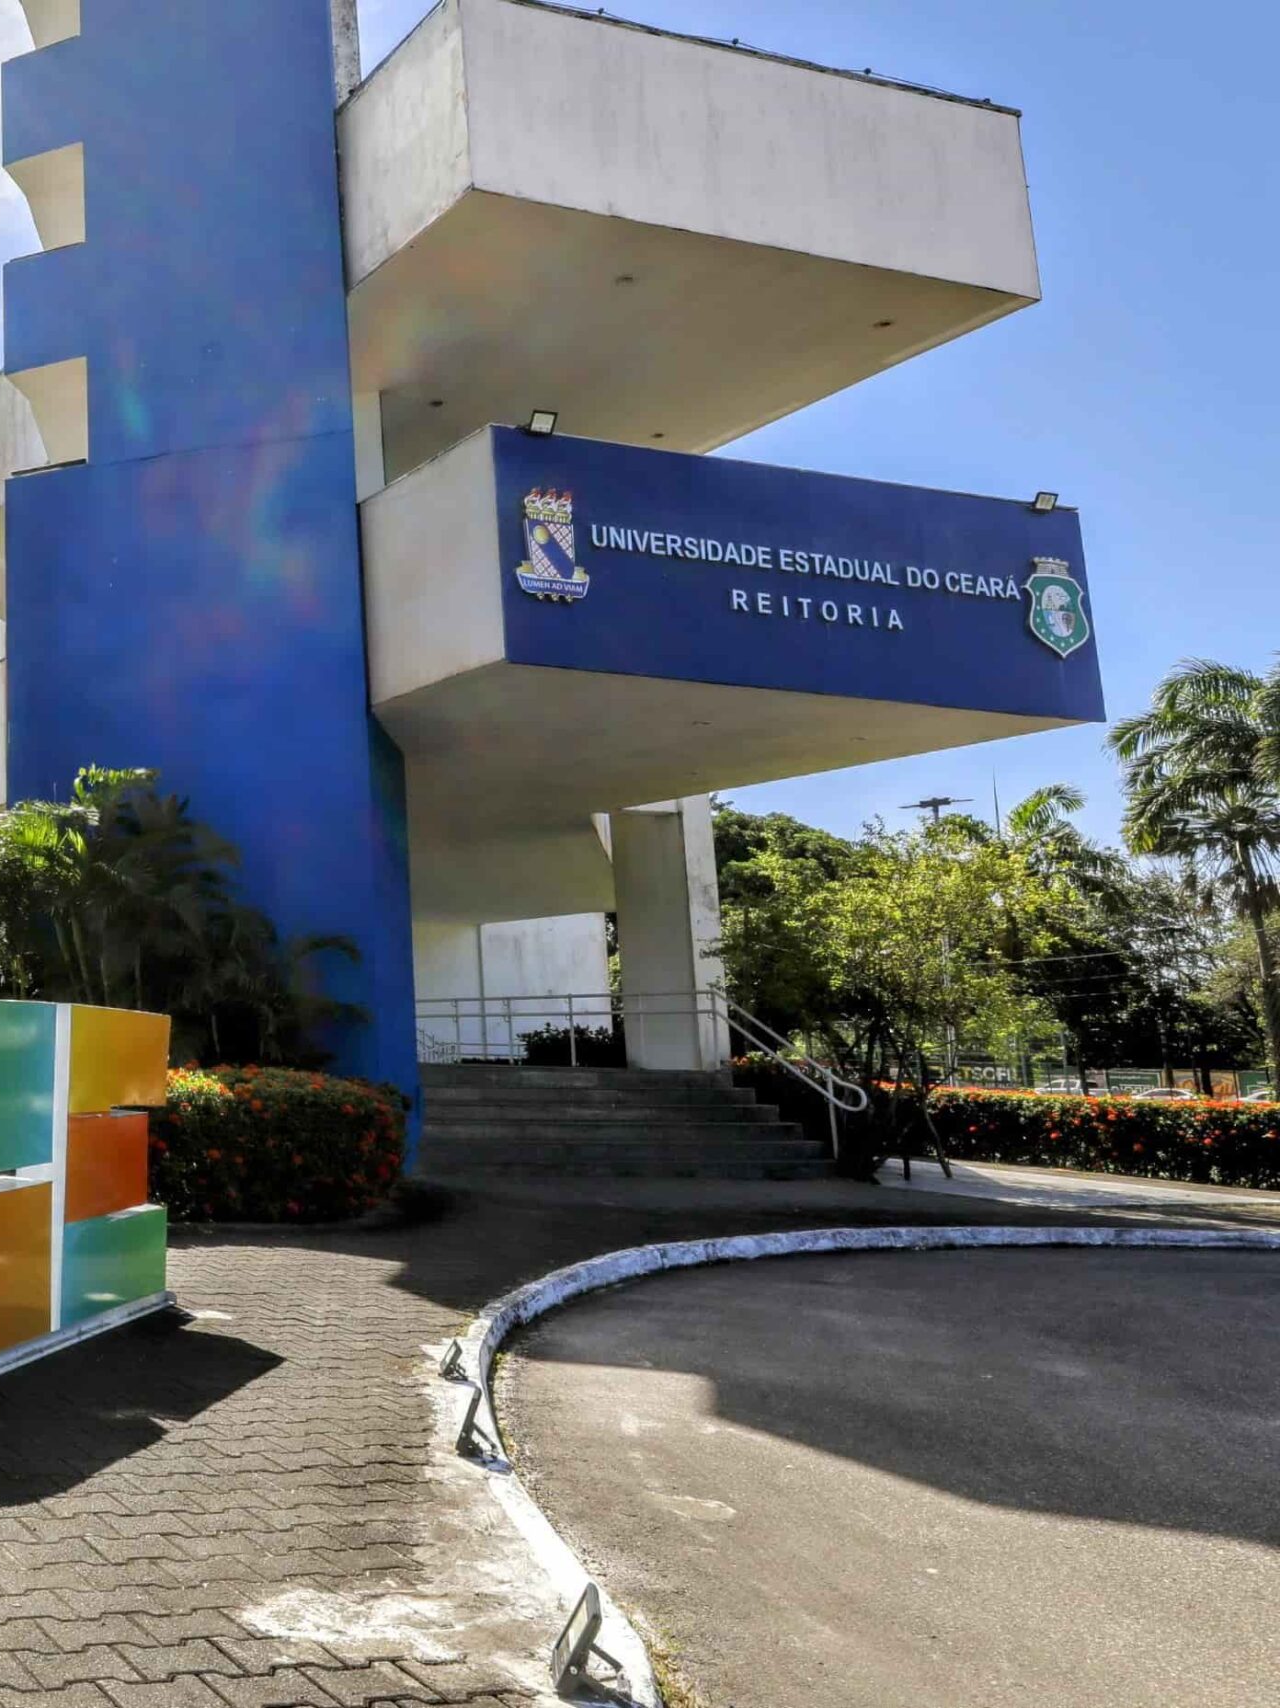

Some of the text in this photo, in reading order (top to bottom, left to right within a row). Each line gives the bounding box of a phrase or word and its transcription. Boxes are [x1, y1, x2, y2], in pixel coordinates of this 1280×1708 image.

[591, 524, 1021, 600] UNIVERSIDADE ESTADUAL DO CEARÁ
[732, 588, 904, 630] REITORIA
